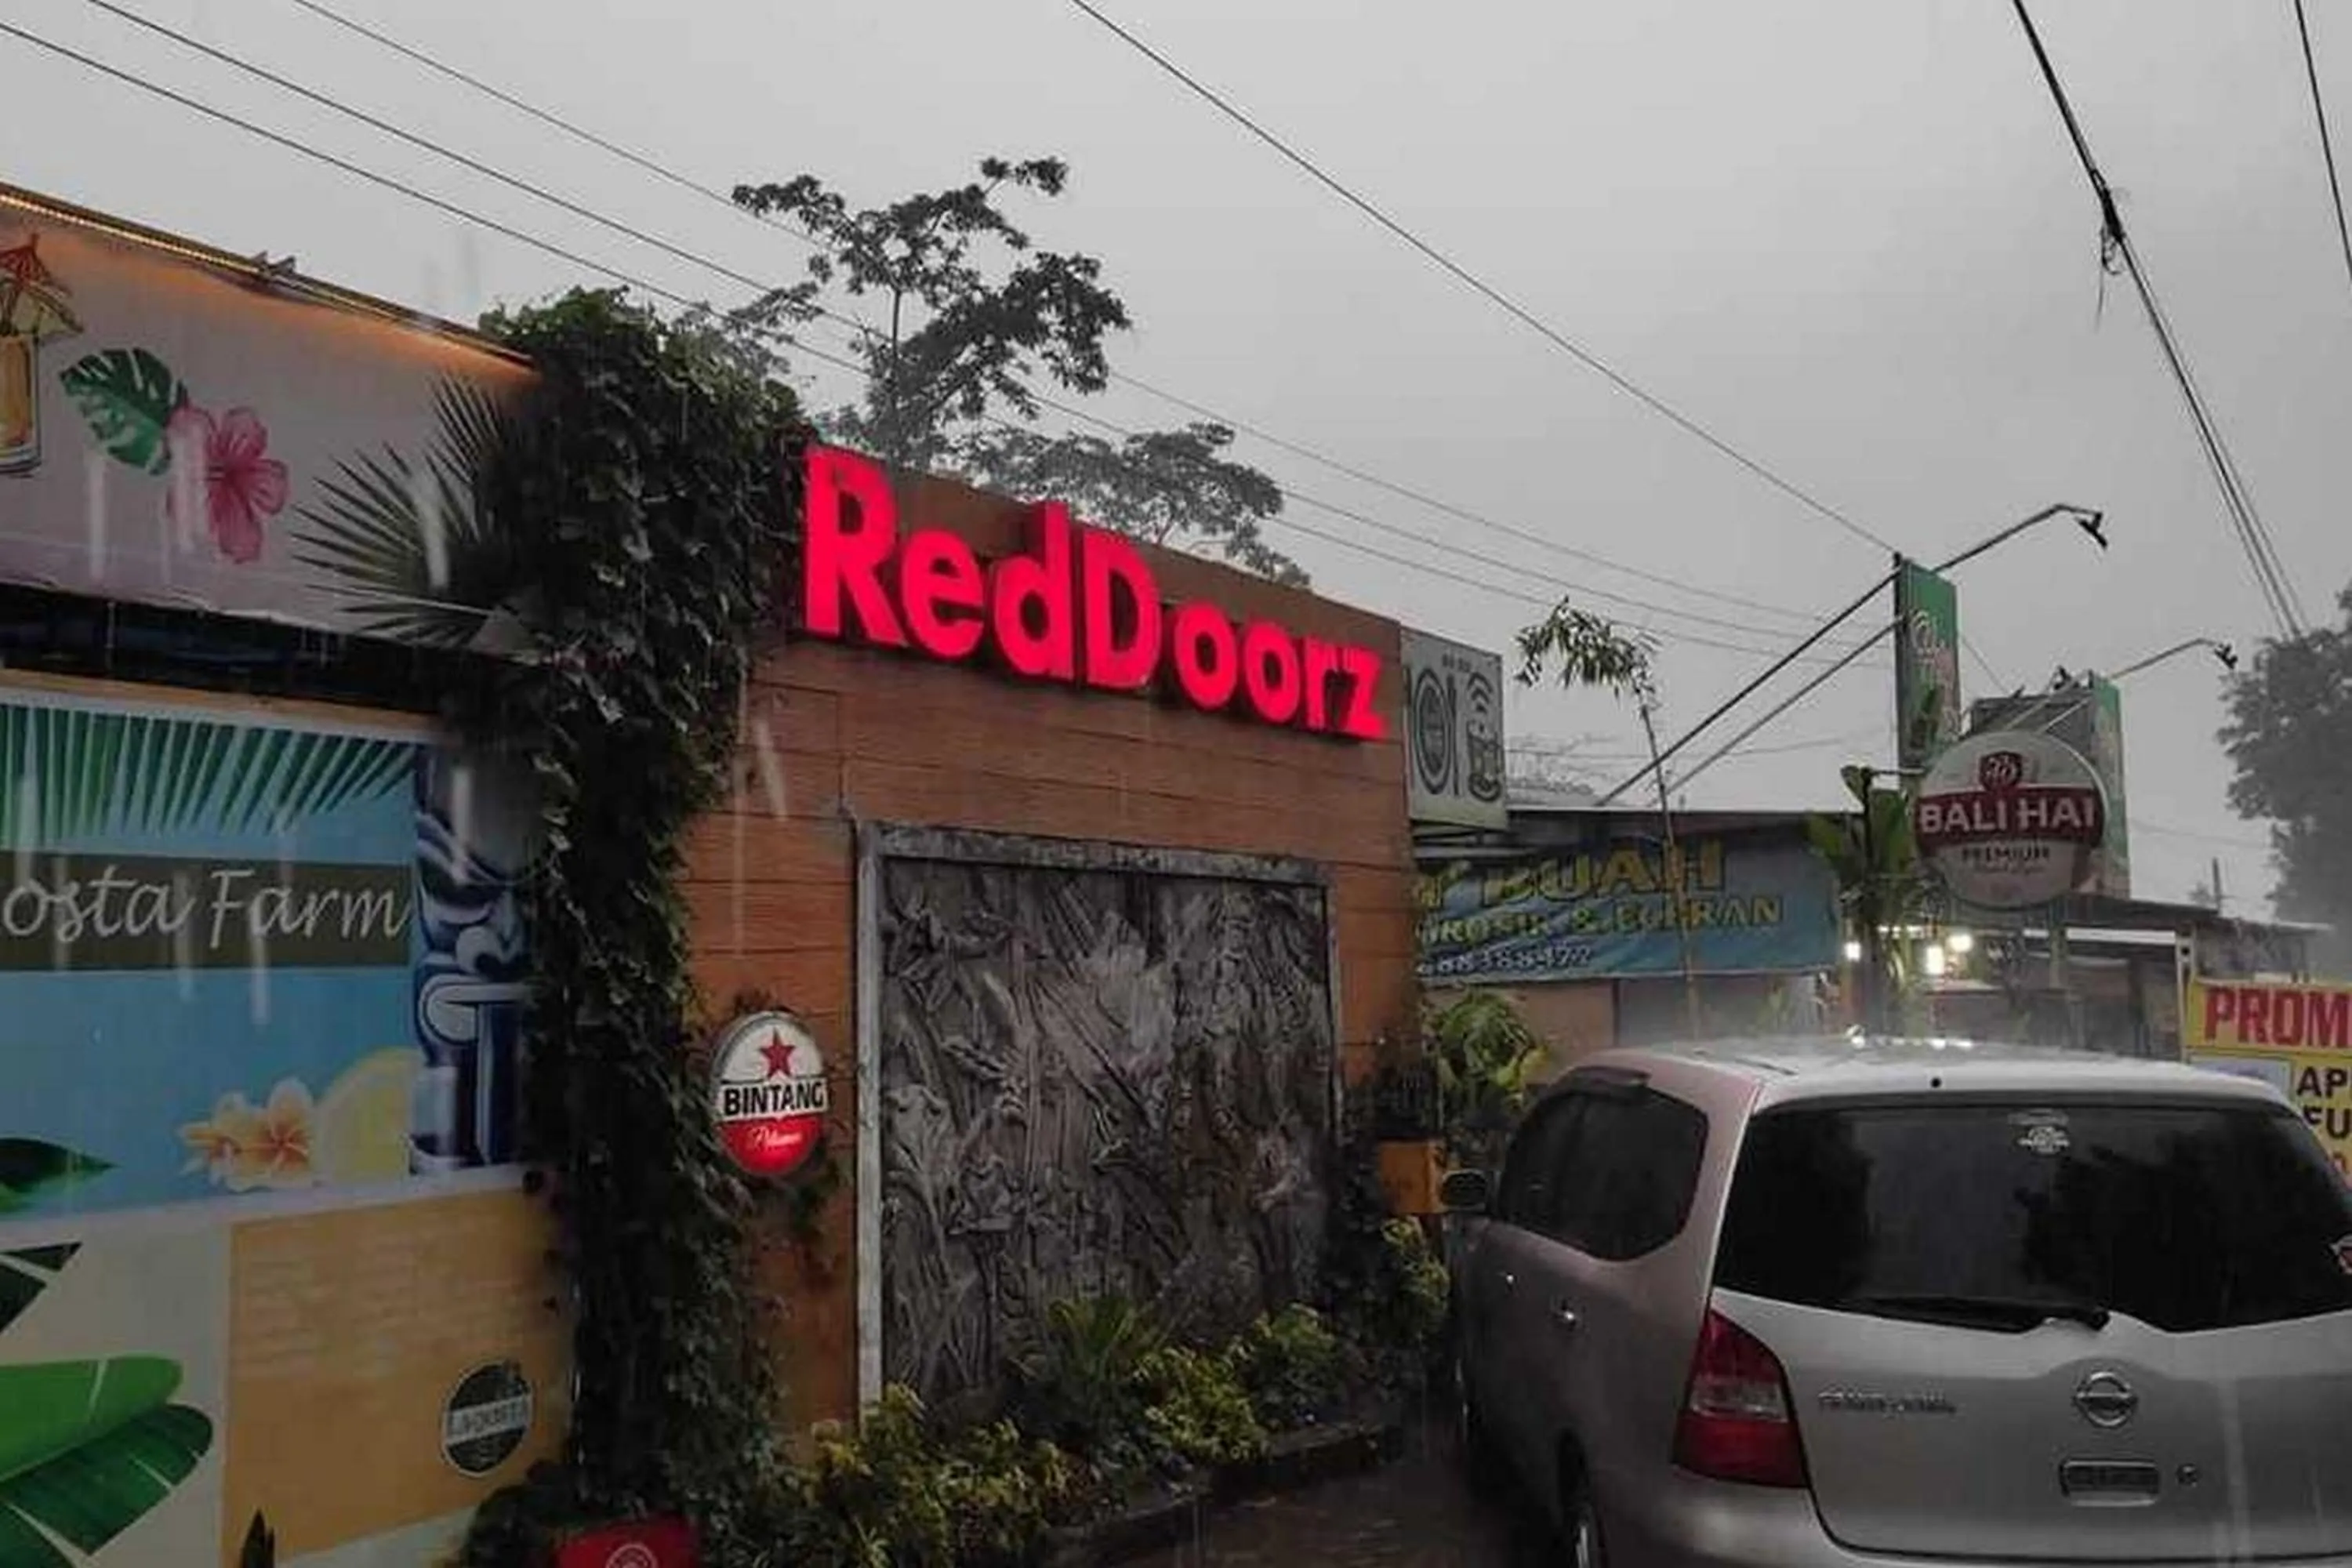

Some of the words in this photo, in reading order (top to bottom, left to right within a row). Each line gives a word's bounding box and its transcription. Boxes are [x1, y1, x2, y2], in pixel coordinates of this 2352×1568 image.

[804, 445, 1388, 741] RedDoorz
[1921, 799, 2008, 835] BALI
[2016, 795, 2095, 831] HAI
[209, 868, 416, 949] Farm
[723, 1081, 823, 1116] BINTANG
